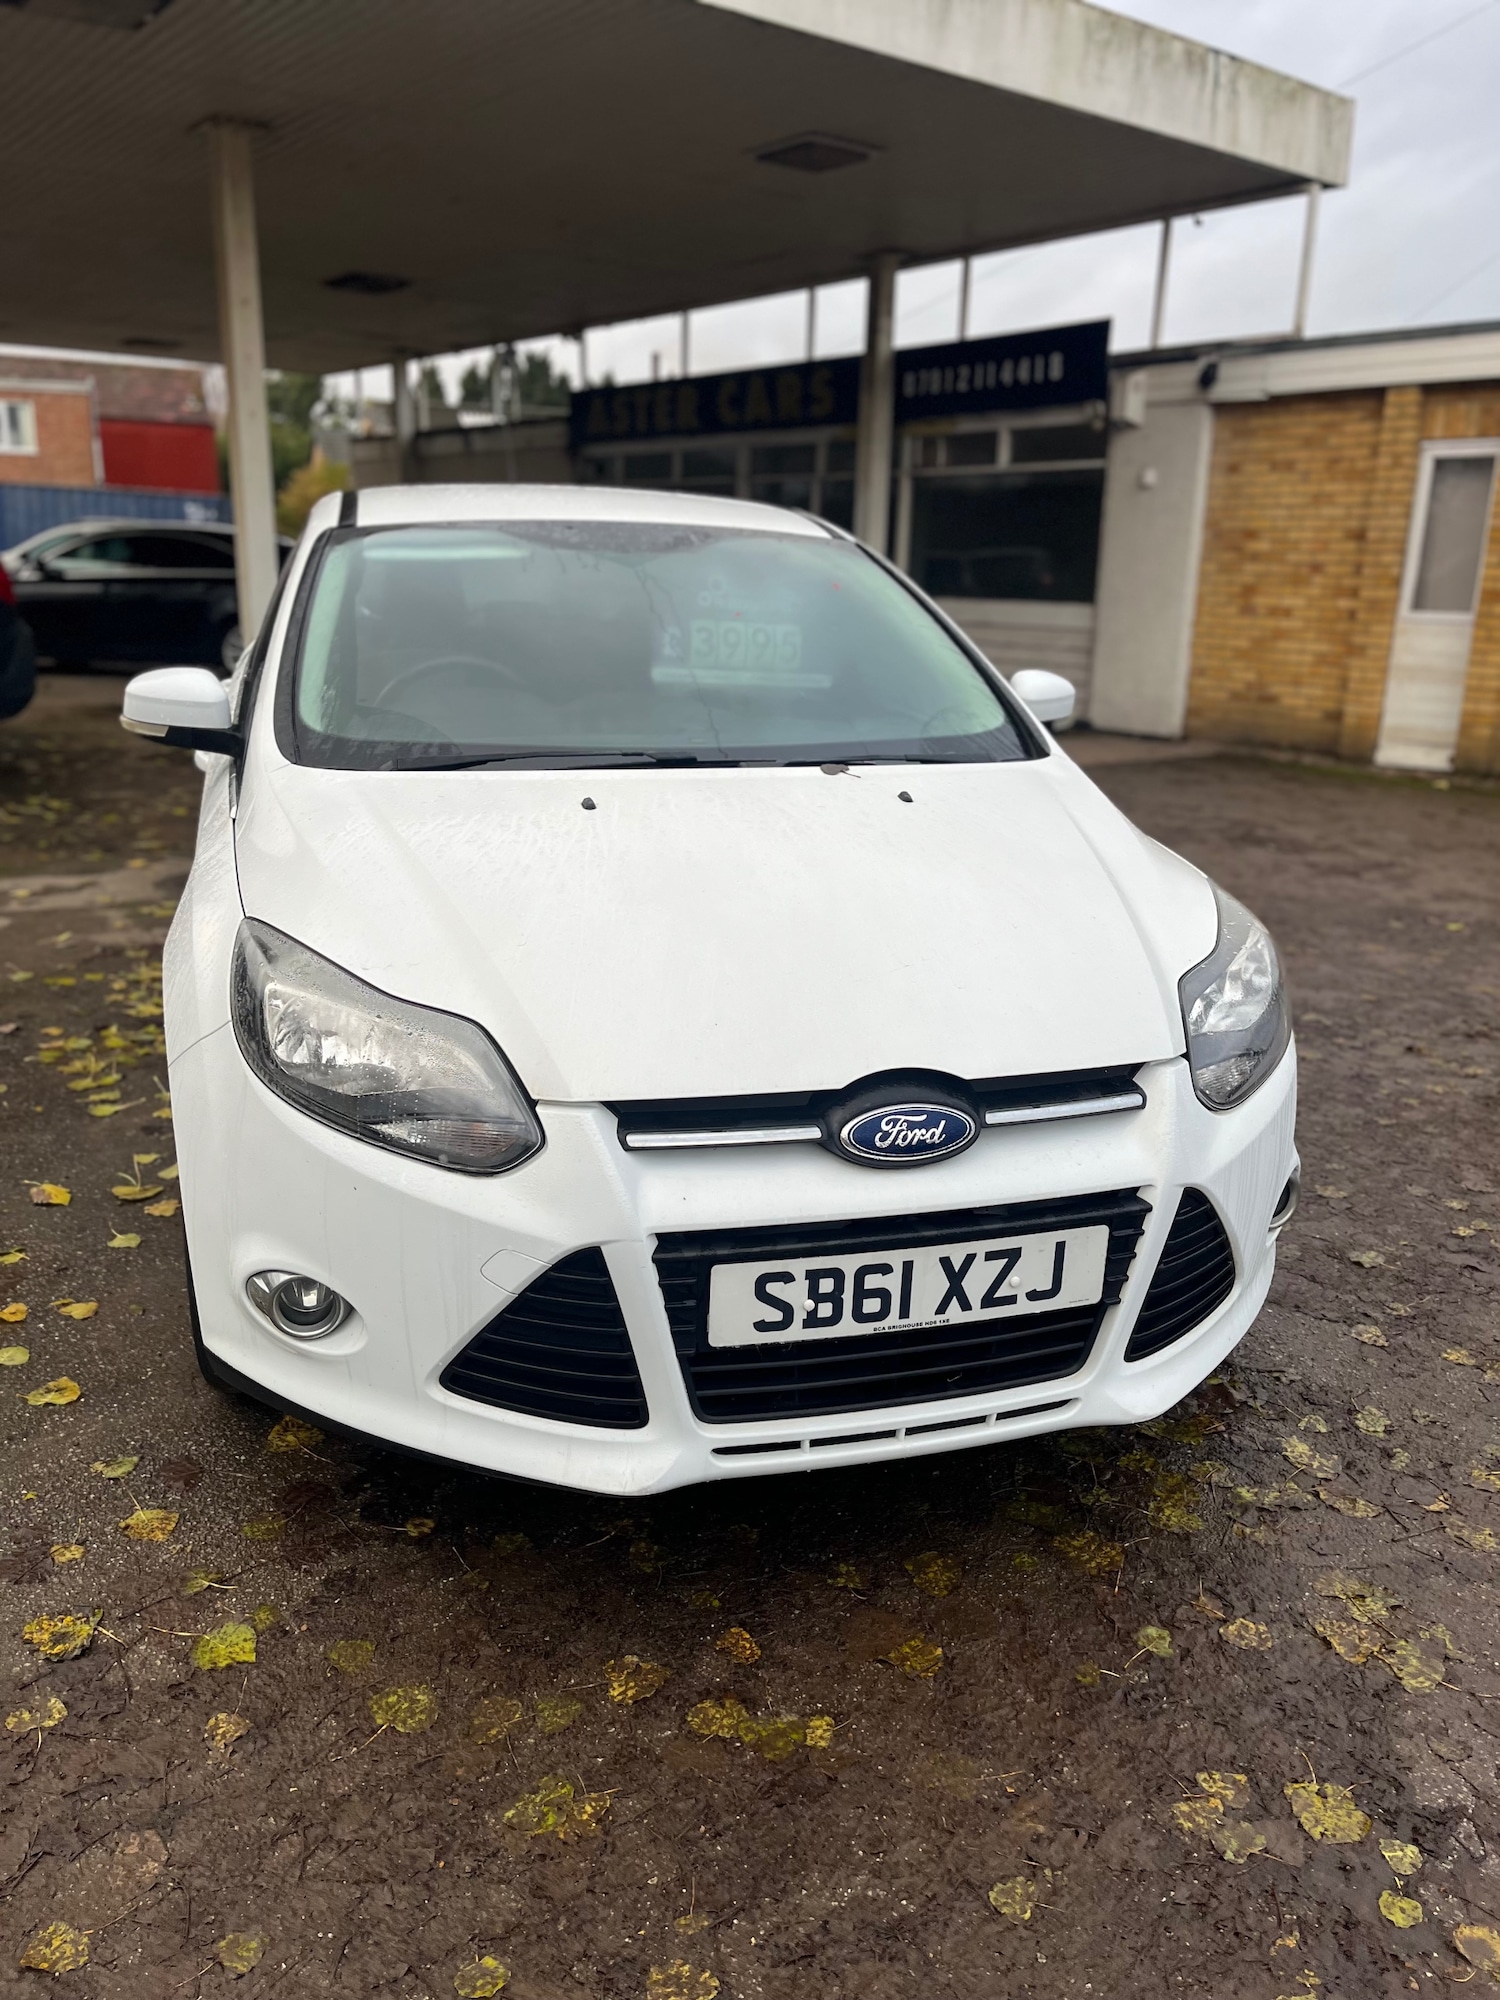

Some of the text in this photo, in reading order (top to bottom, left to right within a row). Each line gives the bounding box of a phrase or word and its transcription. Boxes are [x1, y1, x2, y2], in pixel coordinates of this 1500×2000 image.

[587, 368, 835, 436] ASTER CARS
[693, 624, 799, 664] 3995
[874, 1114, 947, 1149] Ford
[752, 1240, 1067, 1334] SB61 XZJ
